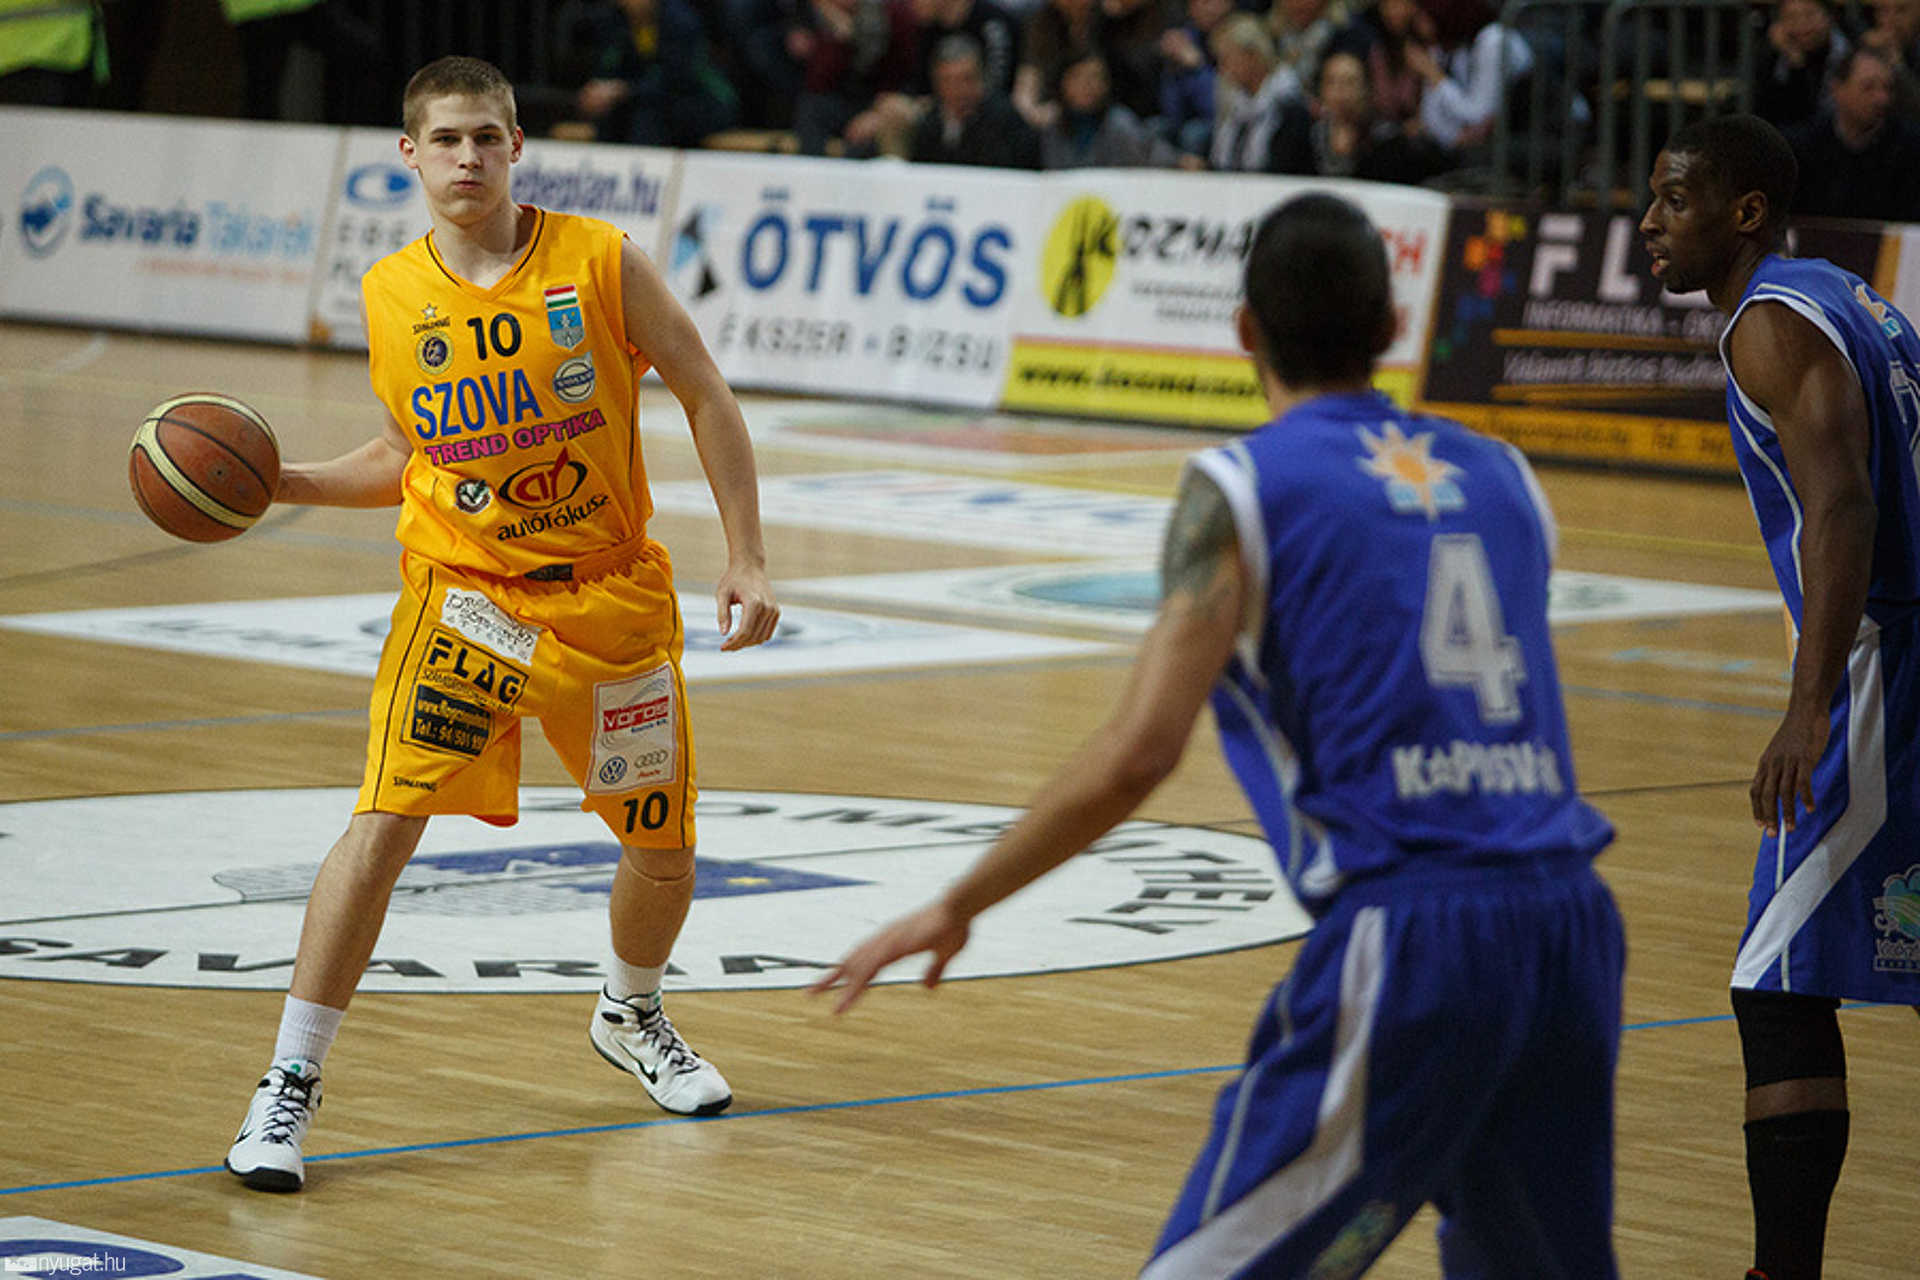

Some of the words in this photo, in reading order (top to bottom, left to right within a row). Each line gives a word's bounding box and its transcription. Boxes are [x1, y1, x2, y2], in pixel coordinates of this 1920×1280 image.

[741, 187, 1012, 308] ÖTVÖS
[1527, 212, 1712, 306] FL
[467, 313, 521, 360] 10
[411, 369, 543, 441] SZOVA
[425, 433, 509, 466] TREND
[513, 408, 606, 449] OPTIKA
[497, 494, 608, 541] autófókusz
[1419, 532, 1528, 725] 4
[428, 637, 521, 704] FLAG
[624, 791, 669, 834] 10
[0, 936, 842, 978] SAVARA
